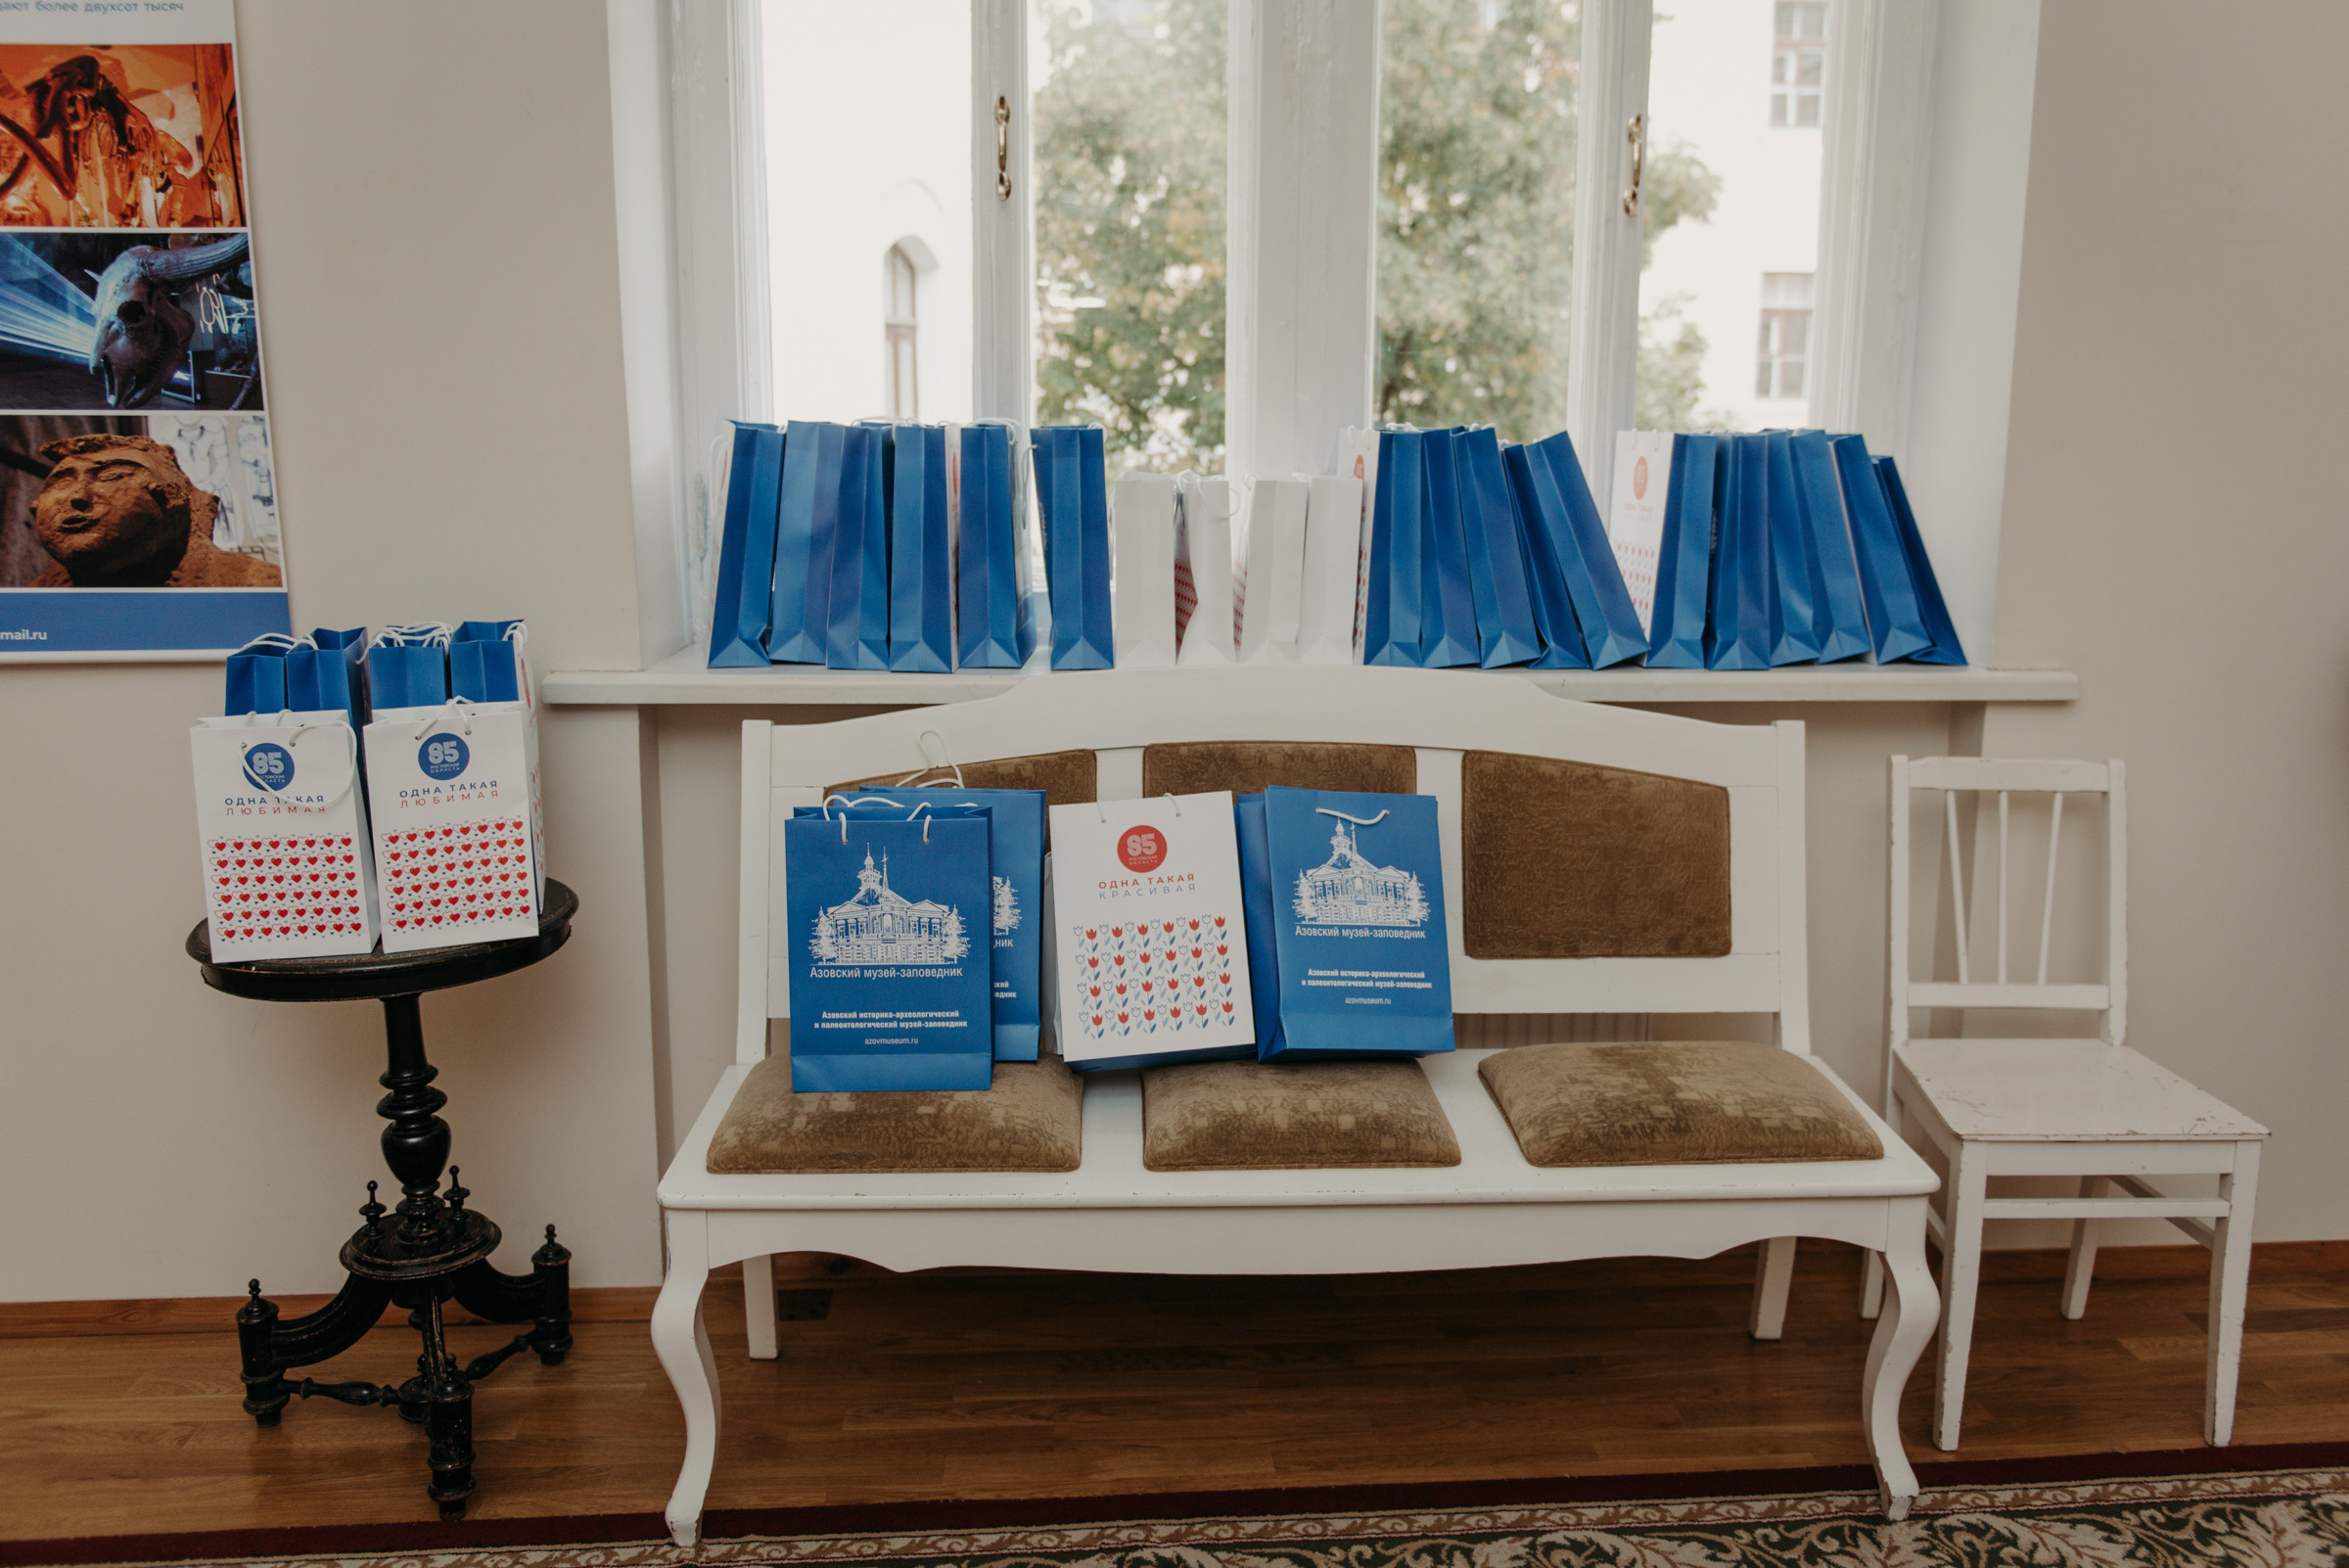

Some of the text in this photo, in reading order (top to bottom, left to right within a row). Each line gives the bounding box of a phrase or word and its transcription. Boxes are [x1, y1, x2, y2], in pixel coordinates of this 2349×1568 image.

[35, 0, 79, 12] более
[84, 1, 139, 15] двухсот
[144, 2, 185, 13] тысяч
[428, 740, 460, 764] 85
[252, 751, 285, 775] 85
[399, 780, 498, 799] ОДНА ТАКАЯ
[224, 795, 325, 807] ОДНА ТКАЯ
[399, 790, 499, 809] ЛЮБИМАЯ
[1126, 832, 1158, 856] 85
[1098, 873, 1195, 891] ОДНА ТАКАЯ
[1098, 883, 1196, 900] КРАСИВАЯ
[1295, 925, 1426, 941] Азовский музей-заповедник
[809, 965, 963, 980] Азовский музей-заповедник
[1308, 967, 1425, 980] Азовский историко-археологический
[1307, 978, 1374, 990] палеонтологический
[1374, 979, 1433, 991] музей-заповедник
[1345, 996, 1392, 1006] azovmuseum.ru
[821, 1009, 960, 1021] Азовский историко-археологический
[820, 1019, 898, 1030] палеонтологический
[898, 1019, 968, 1030] музей-заповедник
[864, 1037, 919, 1045] azovmuseum.ru
